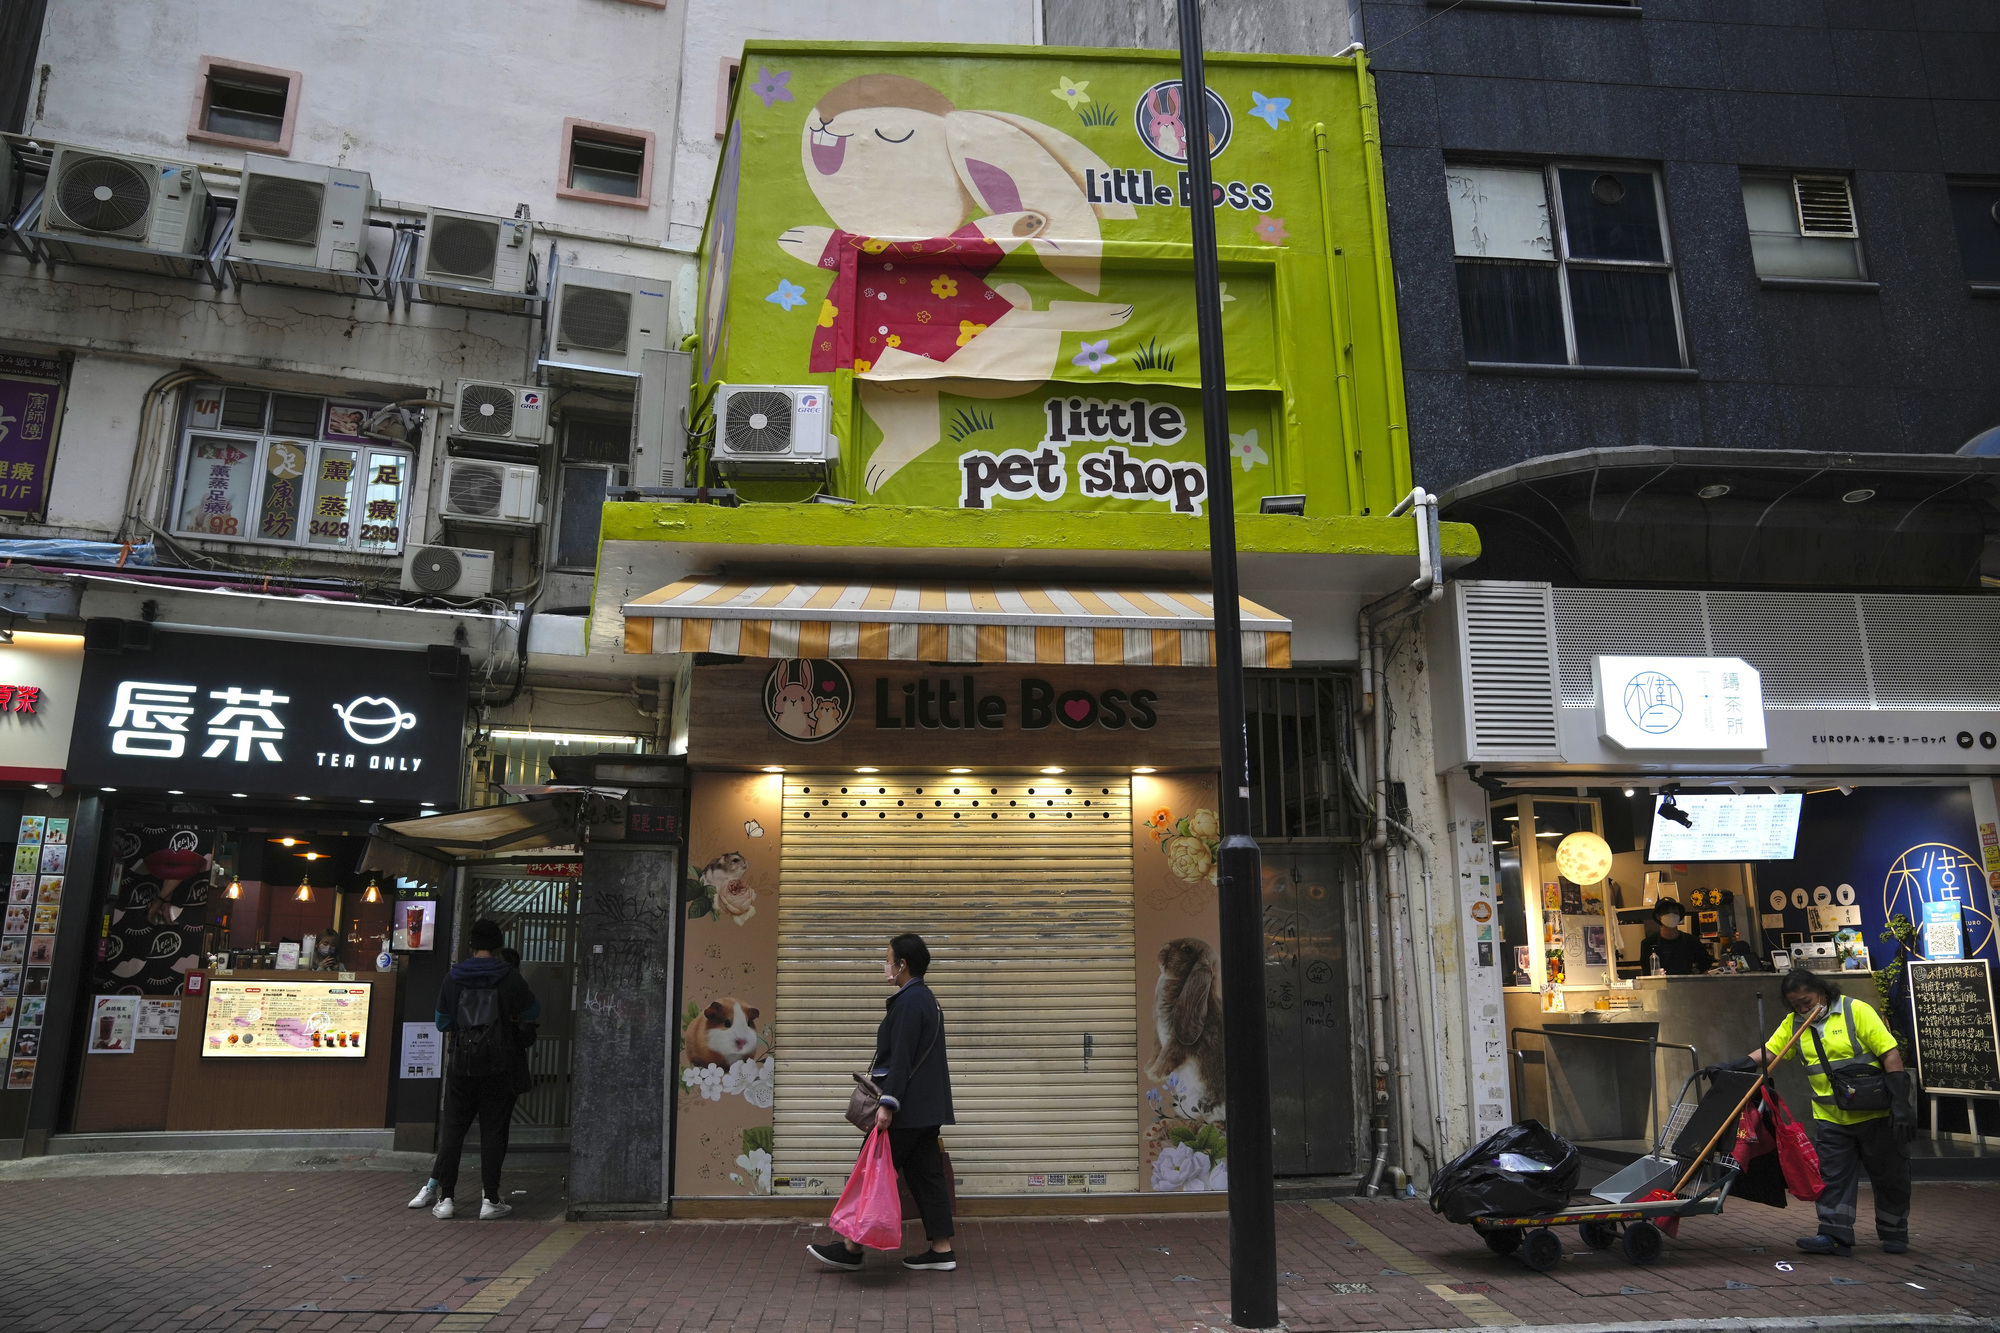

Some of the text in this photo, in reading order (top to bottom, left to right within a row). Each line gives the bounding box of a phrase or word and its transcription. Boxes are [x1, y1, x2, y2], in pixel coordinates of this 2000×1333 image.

[1085, 168, 1173, 205] Little
[520, 403, 541, 411] GREE
[1047, 398, 1183, 443] little
[367, 464, 403, 521] 足療
[963, 448, 1205, 512] pet shop
[209, 516, 239, 536] 98
[309, 520, 350, 538] 3428
[359, 524, 399, 543] 2399
[108, 680, 290, 762] 唇茶
[875, 675, 1158, 730] Little Boss
[316, 752, 422, 771] TEA ONLY
